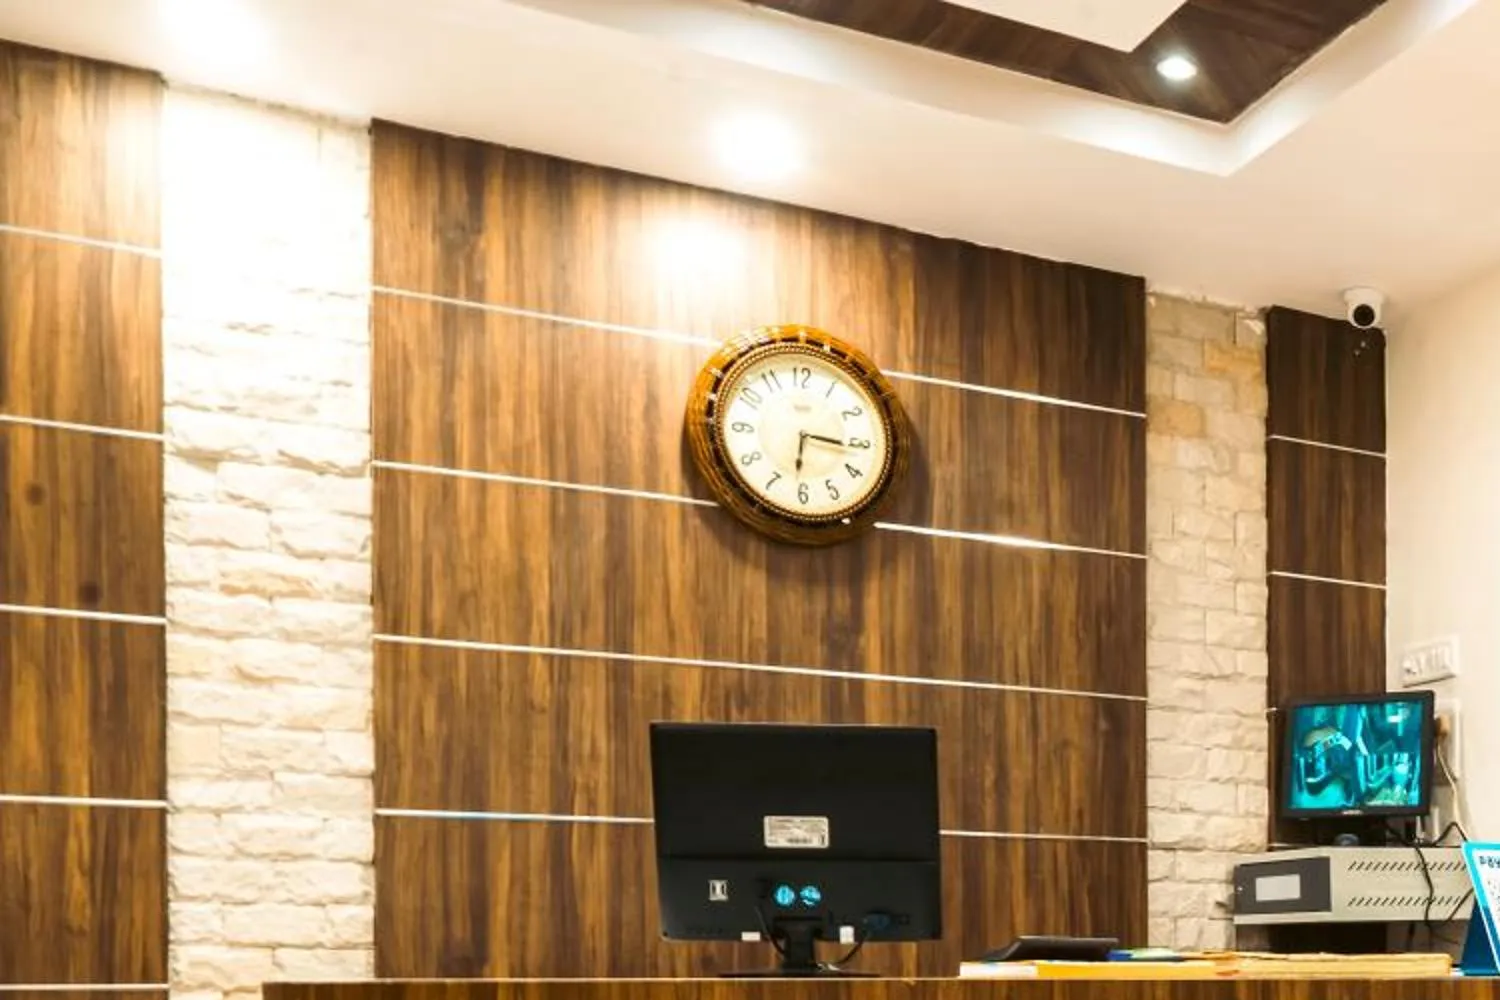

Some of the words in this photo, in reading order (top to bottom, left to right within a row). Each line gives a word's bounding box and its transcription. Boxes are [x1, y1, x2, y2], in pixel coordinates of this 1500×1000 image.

[761, 369, 783, 392] 11
[793, 367, 811, 389] 12
[740, 387, 763, 410] 10
[825, 380, 837, 398] 1
[842, 406, 863, 421] 2
[731, 421, 755, 434] 9
[848, 437, 871, 449] 3
[741, 451, 762, 467] 8
[844, 463, 863, 478] 4
[765, 471, 782, 491] 7
[825, 479, 841, 501] 5
[797, 483, 809, 505] 6
